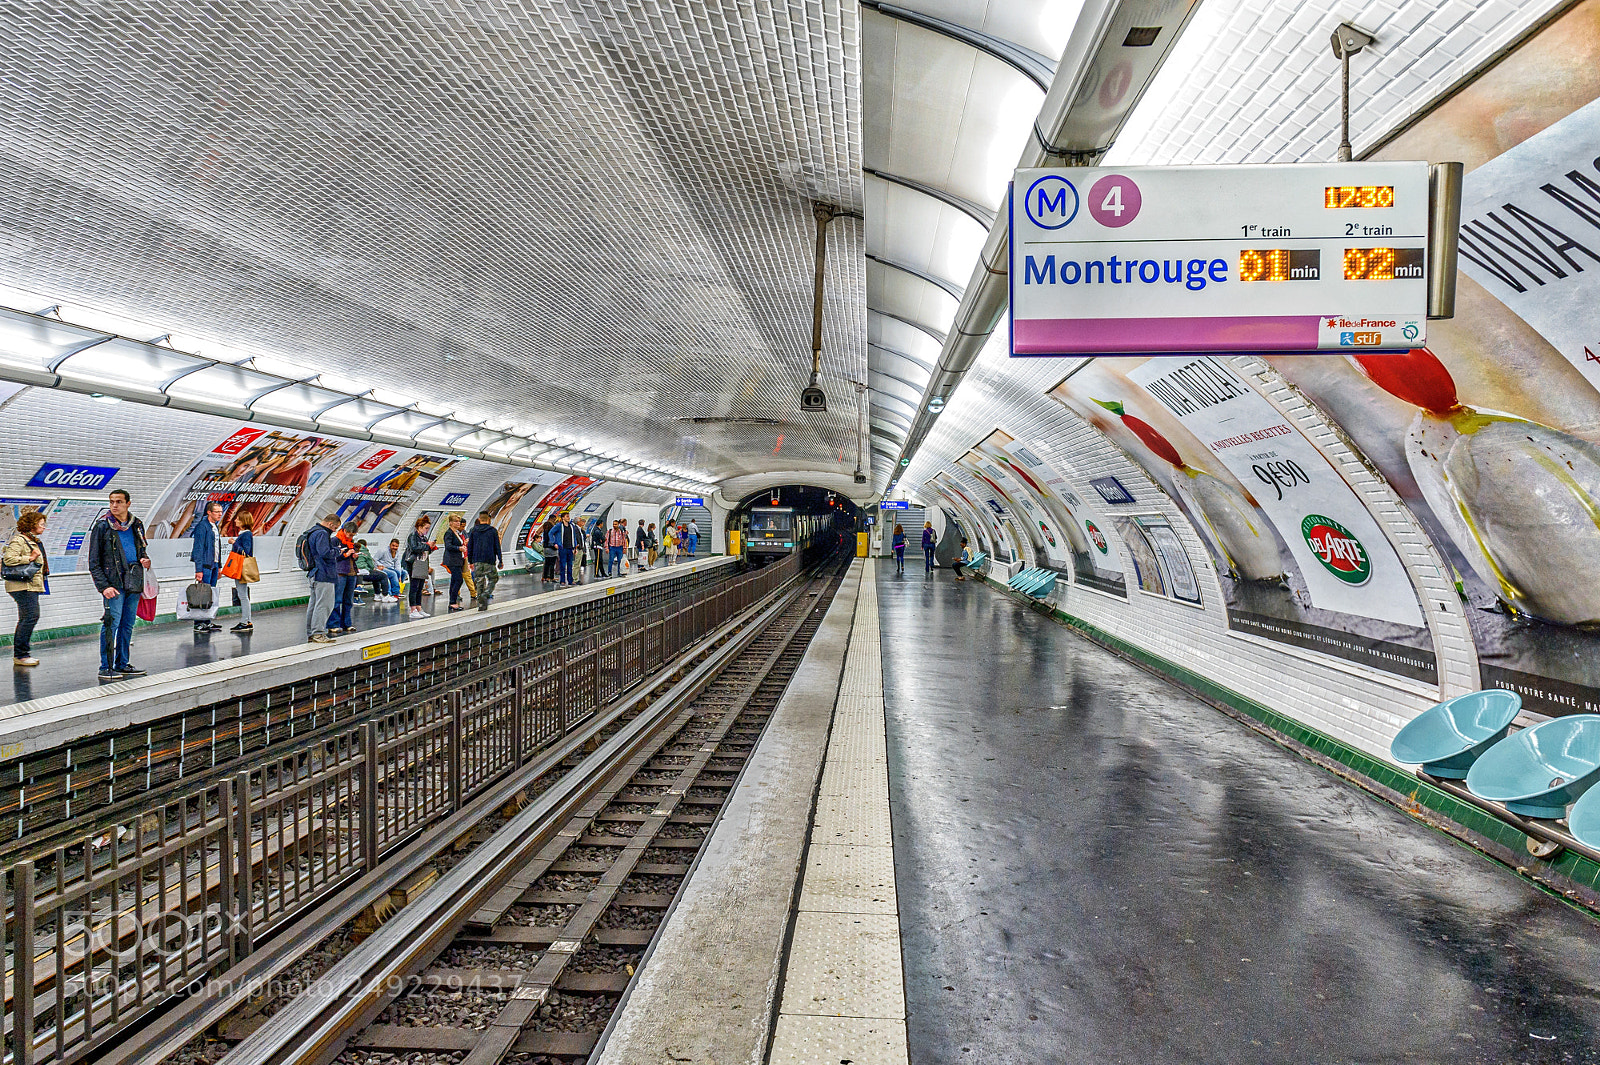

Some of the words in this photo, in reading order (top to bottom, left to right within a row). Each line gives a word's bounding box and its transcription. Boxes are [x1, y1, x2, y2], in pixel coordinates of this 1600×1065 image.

[1101, 186, 1125, 217] 4
[1261, 226, 1291, 237] train
[1363, 224, 1393, 236] train
[1024, 254, 1229, 291] Montrouge
[1239, 249, 1285, 281] 01
[1290, 265, 1318, 278] min
[1343, 248, 1393, 280] 02
[1395, 264, 1422, 277] min
[1356, 332, 1381, 345] stif
[1145, 378, 1200, 417] VIVA
[1213, 433, 1253, 450] NOUVELLES
[1249, 424, 1292, 441] RECETTES
[1209, 443, 1220, 453] 4
[44, 468, 105, 486] Odéon
[1495, 680, 1515, 691] POUR
[1518, 685, 1543, 699] VOTRE
[1548, 692, 1580, 709] SANTÉ,
